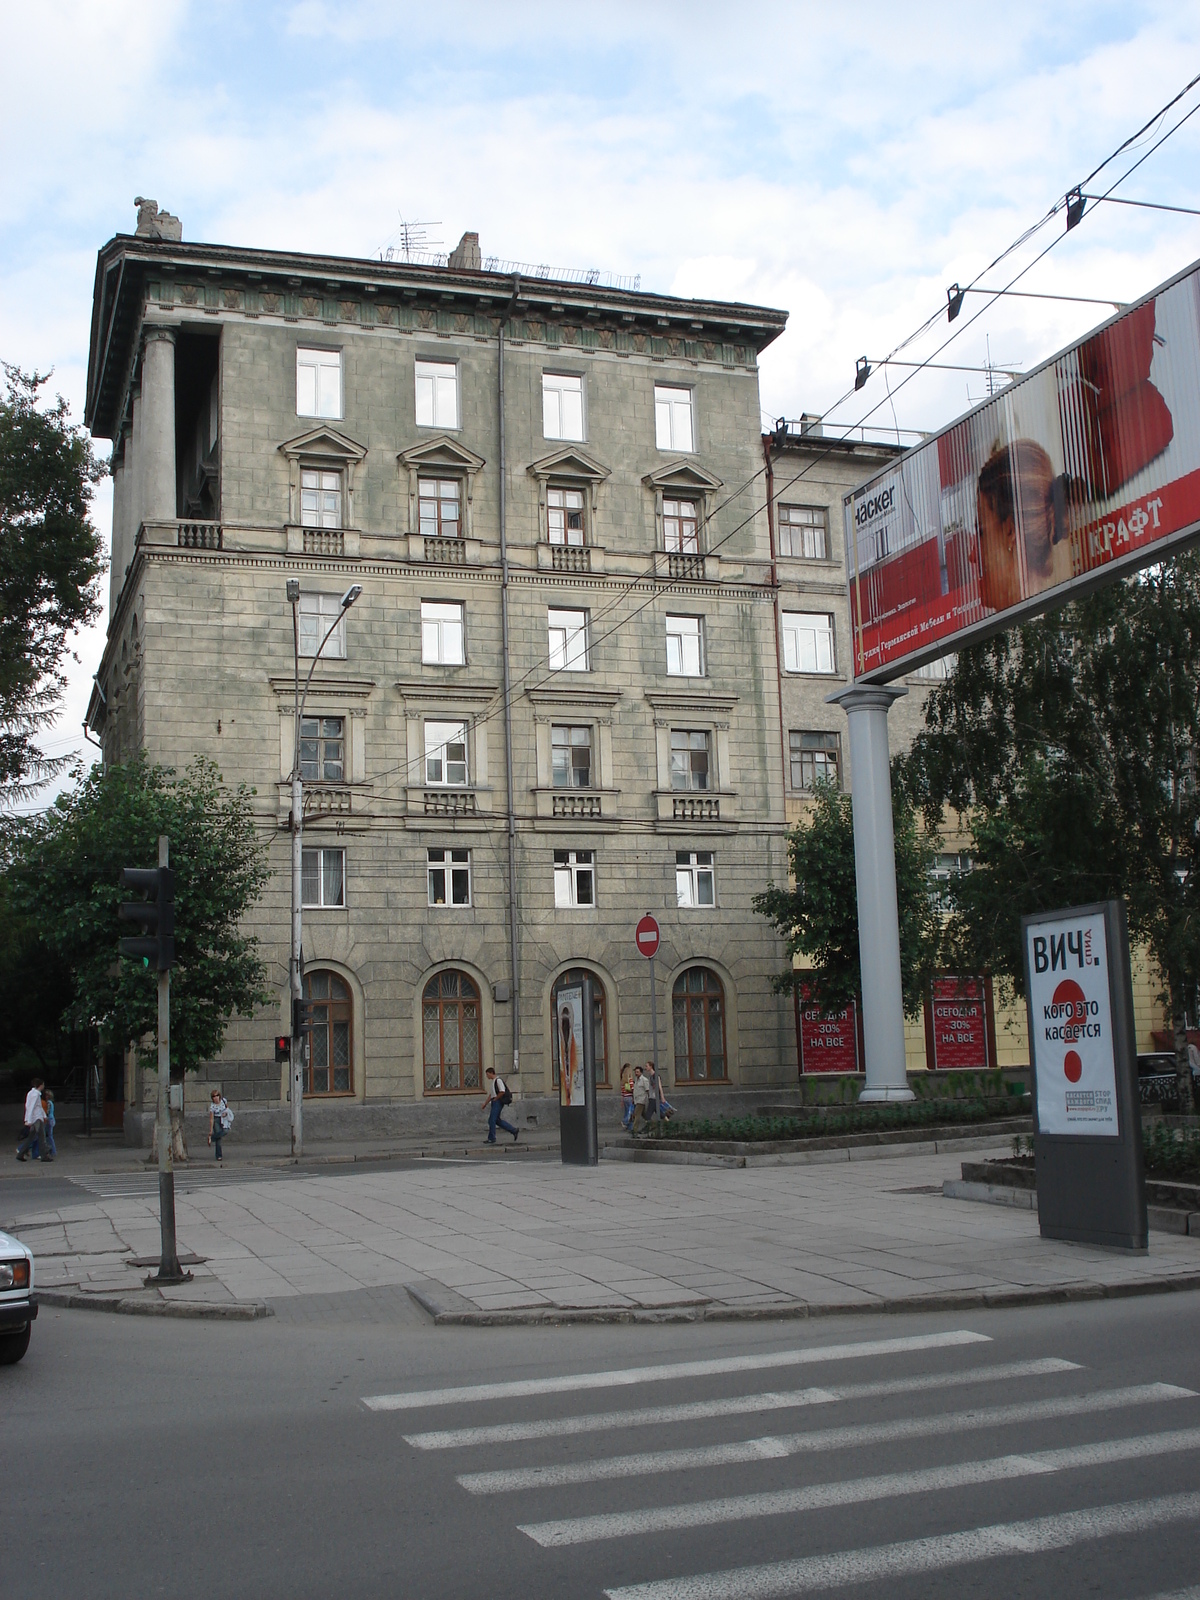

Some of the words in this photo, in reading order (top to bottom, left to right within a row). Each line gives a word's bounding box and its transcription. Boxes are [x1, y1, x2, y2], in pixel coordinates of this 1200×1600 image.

[1089, 497, 1163, 557] КРАФТ
[881, 625, 919, 650] Германской
[1084, 929, 1092, 965] СПИД
[810, 1037, 824, 1047] НА
[826, 1037, 844, 1047] ВСЕ
[942, 1034, 955, 1042] НА
[957, 1034, 974, 1042] ВСЕ
[1045, 1024, 1101, 1040] касается
